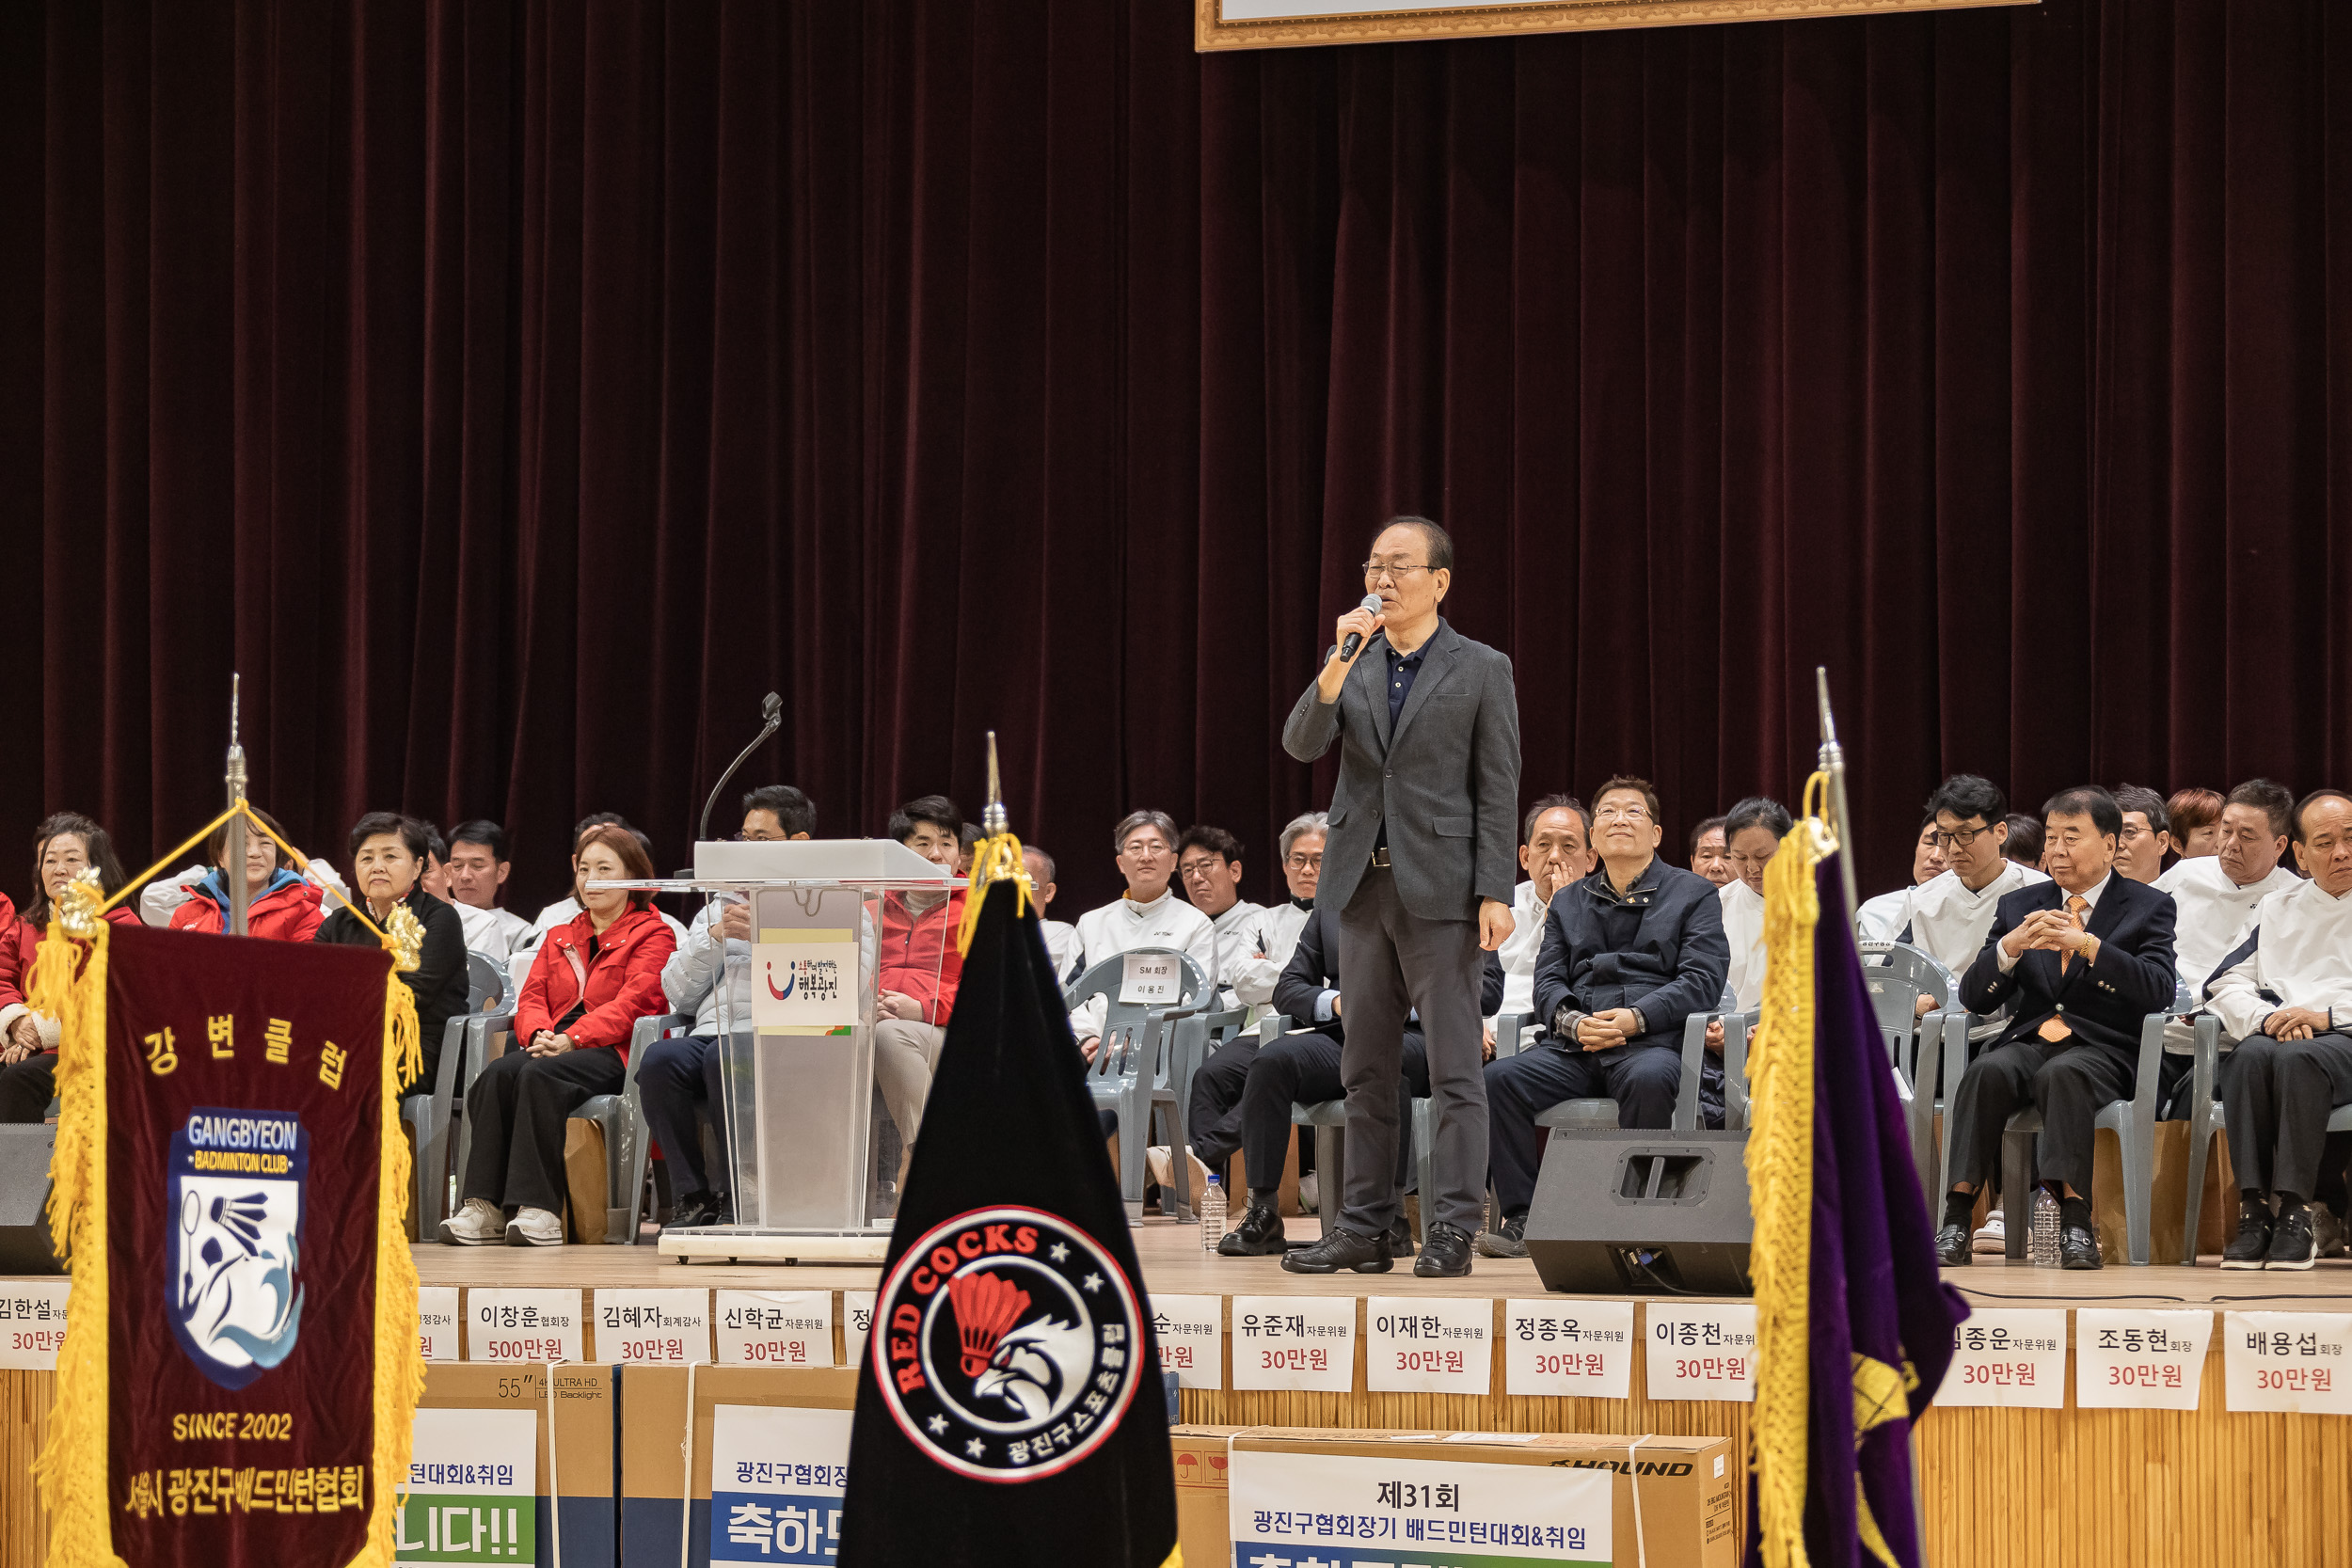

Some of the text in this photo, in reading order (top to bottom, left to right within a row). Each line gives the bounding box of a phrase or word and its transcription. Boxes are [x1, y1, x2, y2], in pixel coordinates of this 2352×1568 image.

[1139, 966, 1168, 975] SM 회장
[799, 974, 836, 1001] 행복광진
[144, 1013, 348, 1091] 강변클럽
[188, 1115, 298, 1150] GANGBYEON
[194, 1149, 289, 1174] BADMINTON CLUB
[0, 1298, 52, 1321] 김한설
[481, 1306, 570, 1328] 이창훈 협회장
[603, 1306, 702, 1329] 김혜자 회계감사
[723, 1307, 823, 1330] 신학균 자문위원
[891, 1224, 1040, 1395] RED COCKS
[1172, 1323, 1213, 1336] 자문위원
[1241, 1314, 1347, 1338] 유준재 자문위원
[1376, 1315, 1484, 1339] 이재한 자문위원
[1515, 1318, 1624, 1342] 정종옥 자문위원
[1656, 1322, 1757, 1346] 이종천 자문위
[488, 1338, 563, 1360] 500만원
[621, 1338, 684, 1360] 30만원
[743, 1340, 806, 1362] 30만원
[2012, 1338, 2057, 1351] 자문위원
[2098, 1328, 2193, 1353] 조동현 회장
[2247, 1331, 2343, 1355] 배용섭 회장
[1261, 1348, 1328, 1371] 30만원
[1396, 1350, 1464, 1373] 30만원
[1535, 1353, 1604, 1376] 30만원
[1676, 1357, 1745, 1380] 30만원
[553, 1378, 582, 1387] ULTRA
[584, 1378, 598, 1387] HD
[1963, 1362, 2035, 1386] 30만원
[2108, 1364, 2182, 1388] 30만원
[2257, 1368, 2332, 1392] 30만원
[560, 1390, 603, 1401] Backlight
[172, 1412, 293, 1441] SINCE 2002
[1376, 1480, 1460, 1513] 제31회
[1253, 1510, 1586, 1550] 광진구협회장기 배드민턴대회&취임
